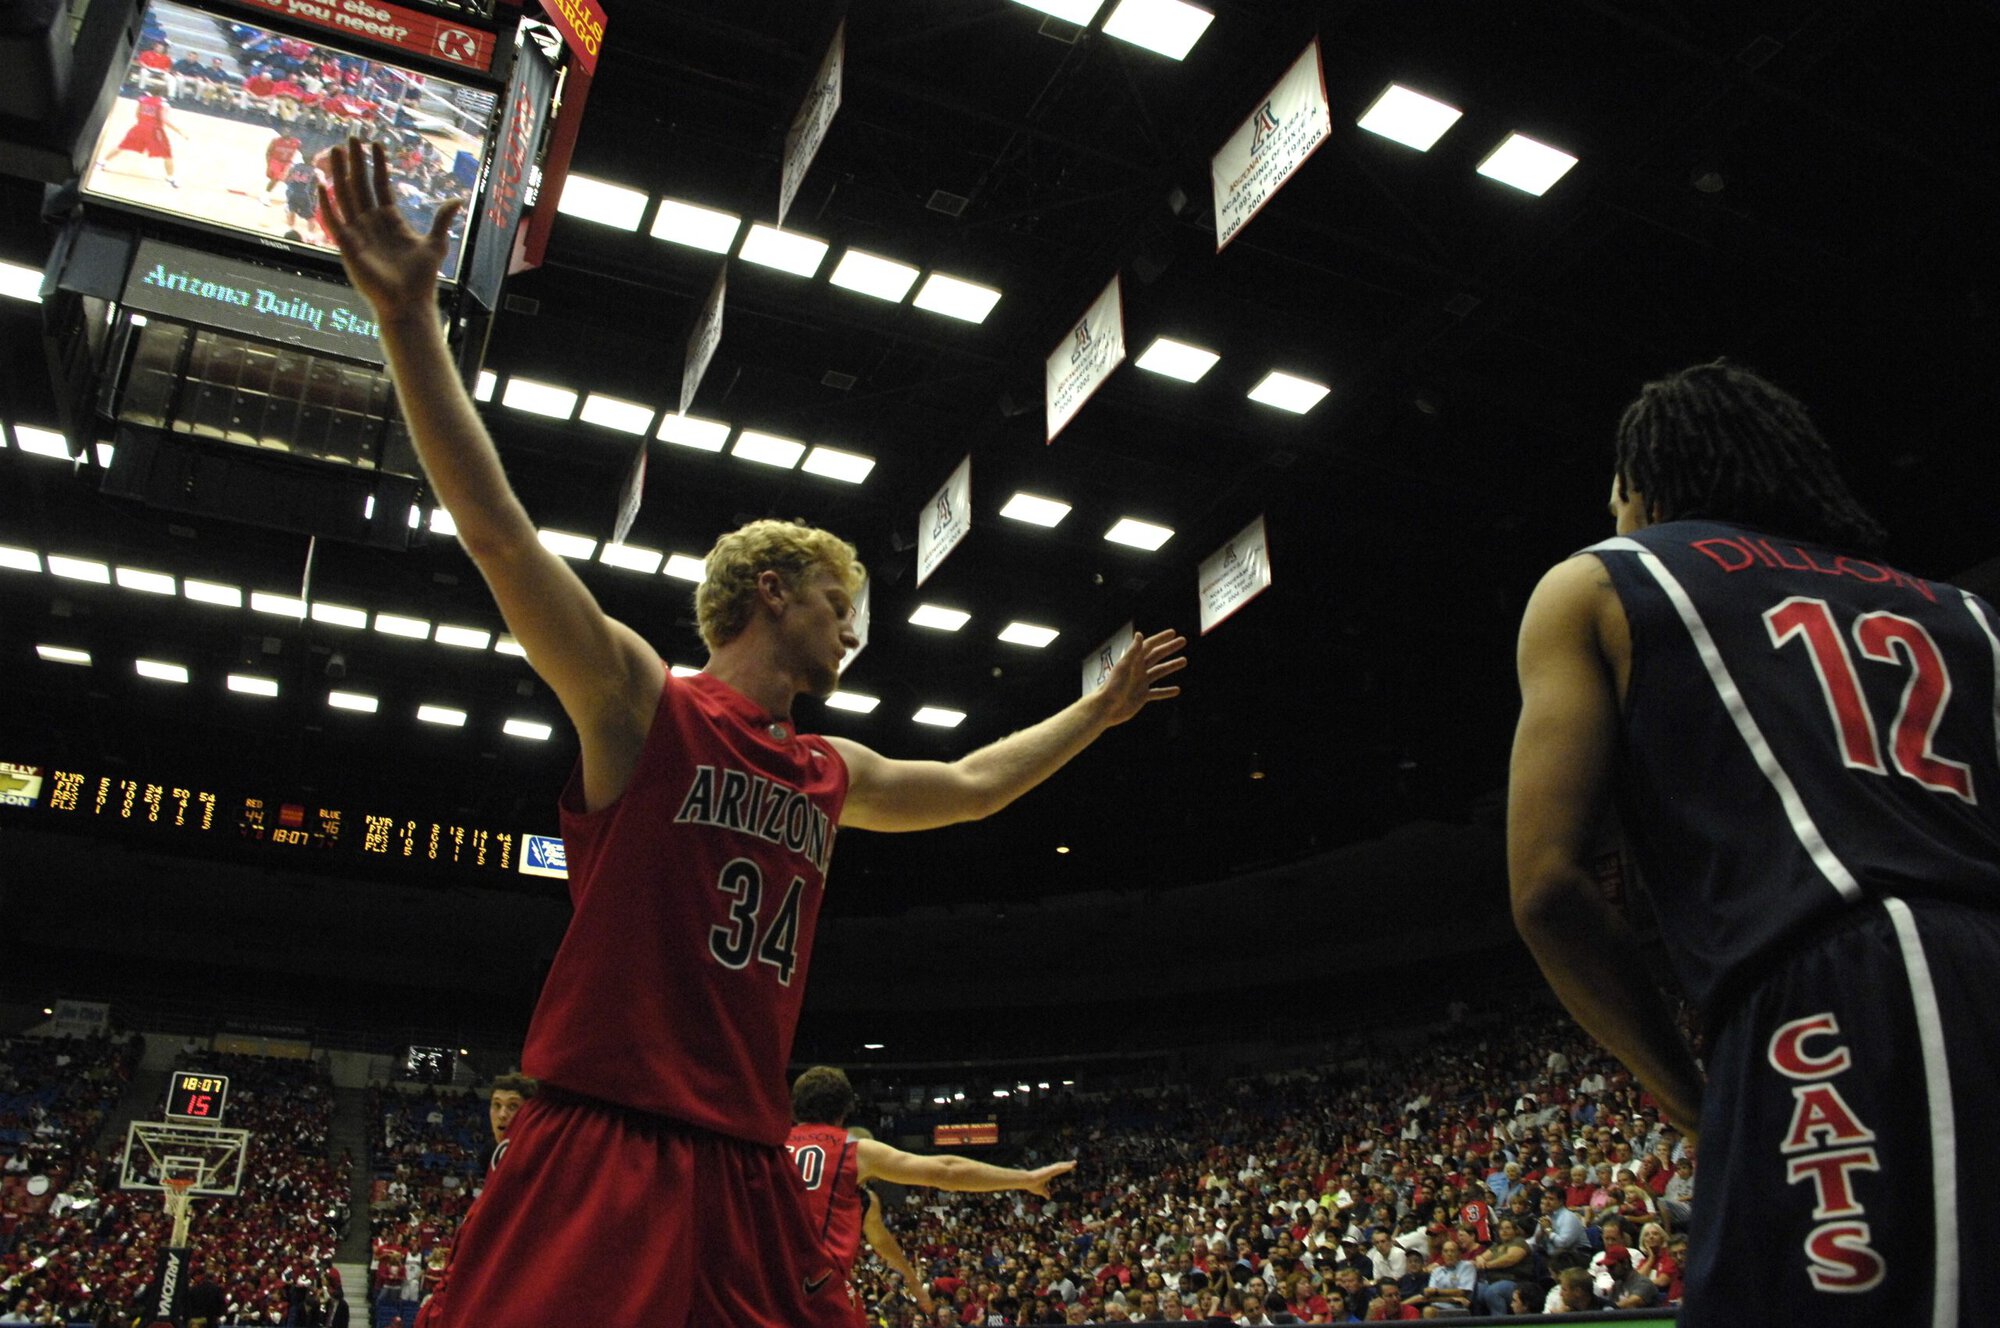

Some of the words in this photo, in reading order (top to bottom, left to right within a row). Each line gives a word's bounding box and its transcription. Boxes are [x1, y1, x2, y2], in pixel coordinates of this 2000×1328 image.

[287, 0, 331, 21] you
[335, 12, 409, 43] need?
[343, 0, 392, 23] else
[1221, 191, 1242, 216] NCAA
[1242, 161, 1270, 194] ROUND
[1221, 216, 1242, 241] 2000
[1247, 188, 1267, 214] 2001
[1272, 160, 1295, 186] 2002
[143, 263, 252, 307] Arizona
[254, 287, 325, 332] Daily
[1689, 536, 1938, 603] DILLON
[1761, 595, 1978, 806] 12
[0, 761, 37, 775] ELLY
[54, 770, 85, 784] PLYR
[172, 787, 190, 799] 50
[245, 809, 264, 824] 44
[319, 808, 342, 820] BLUE
[321, 820, 342, 835] 46
[366, 814, 393, 827] PLYR
[673, 764, 837, 889] ARIZON
[272, 828, 309, 846] 18:07
[708, 857, 806, 988] 34
[182, 1076, 223, 1094] 18:07
[187, 1094, 213, 1117] 15
[785, 1138, 826, 1191] 0
[1767, 1012, 1886, 1293] CATS
[157, 1252, 181, 1317] ARIZONA
